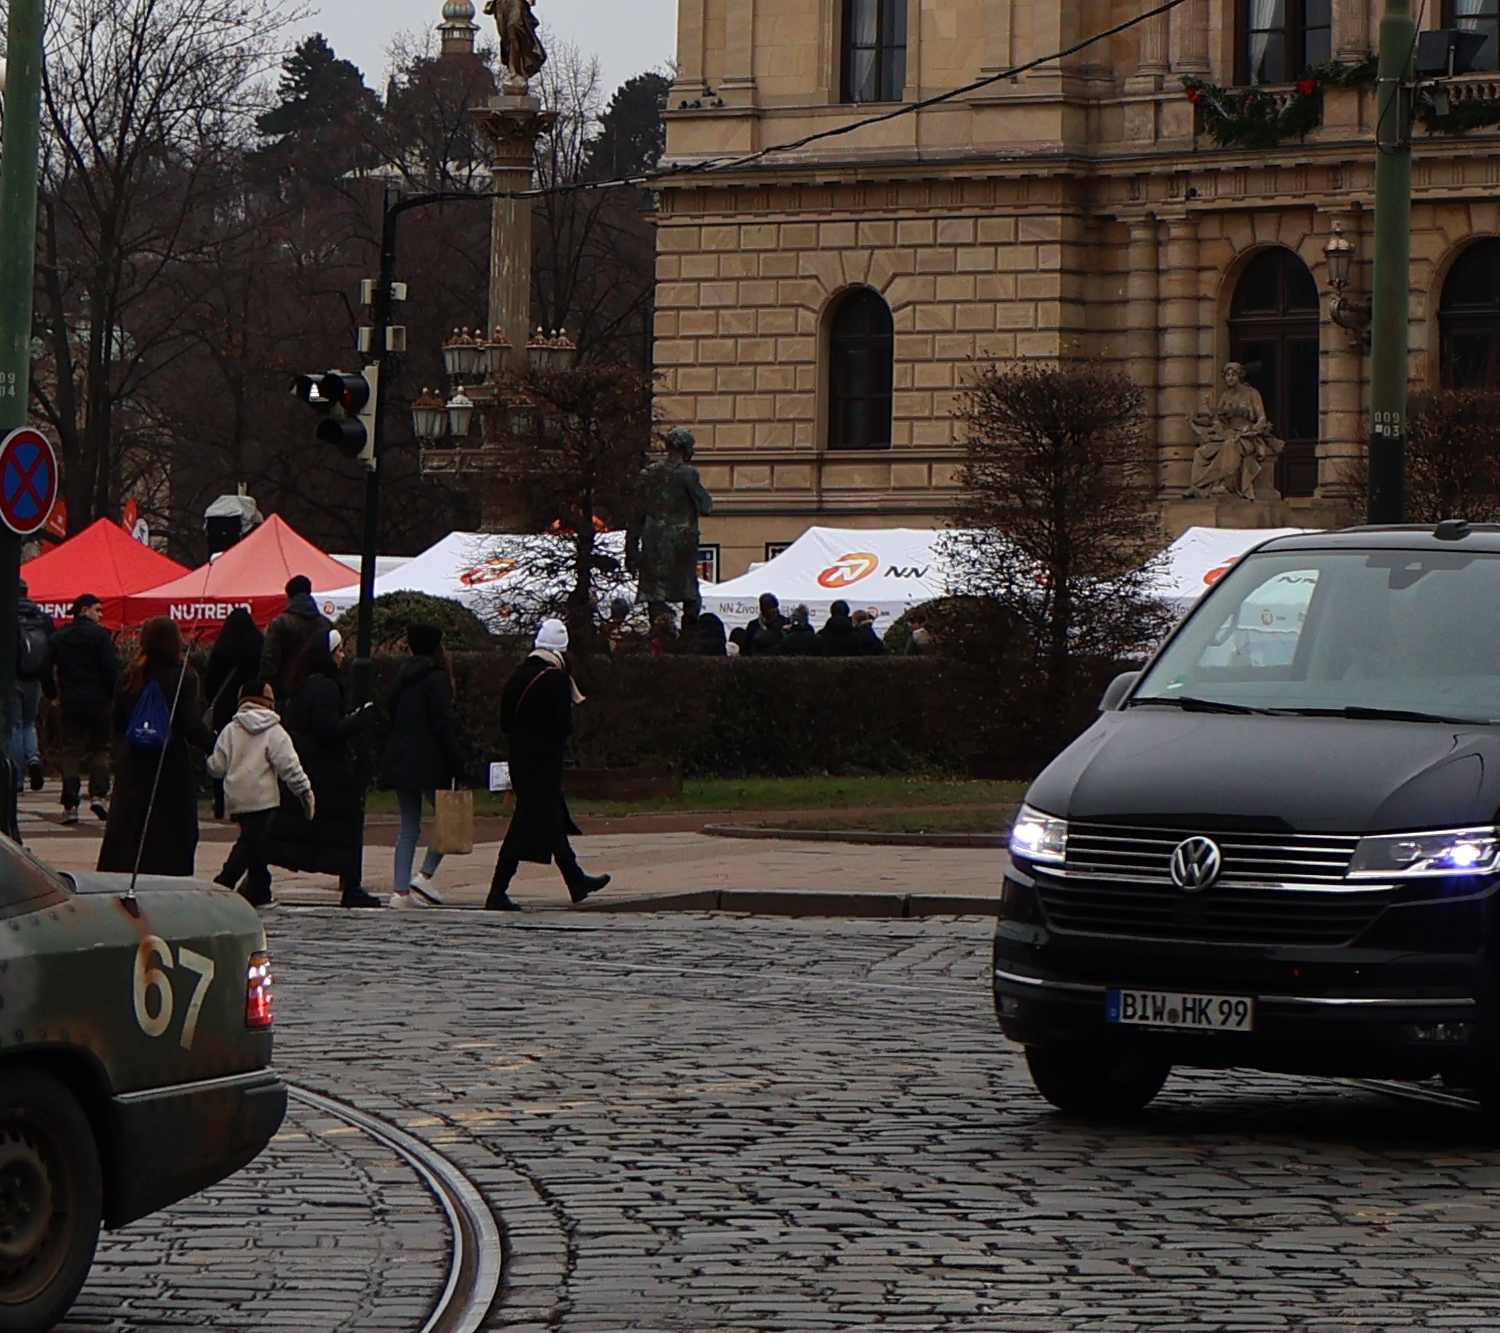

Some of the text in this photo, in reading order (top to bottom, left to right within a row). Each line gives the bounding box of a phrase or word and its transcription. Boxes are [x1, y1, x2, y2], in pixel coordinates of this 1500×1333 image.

[1374, 411, 1400, 423] 009
[133, 934, 215, 1051] 67
[1123, 993, 1248, 1026] BIW HK 99
